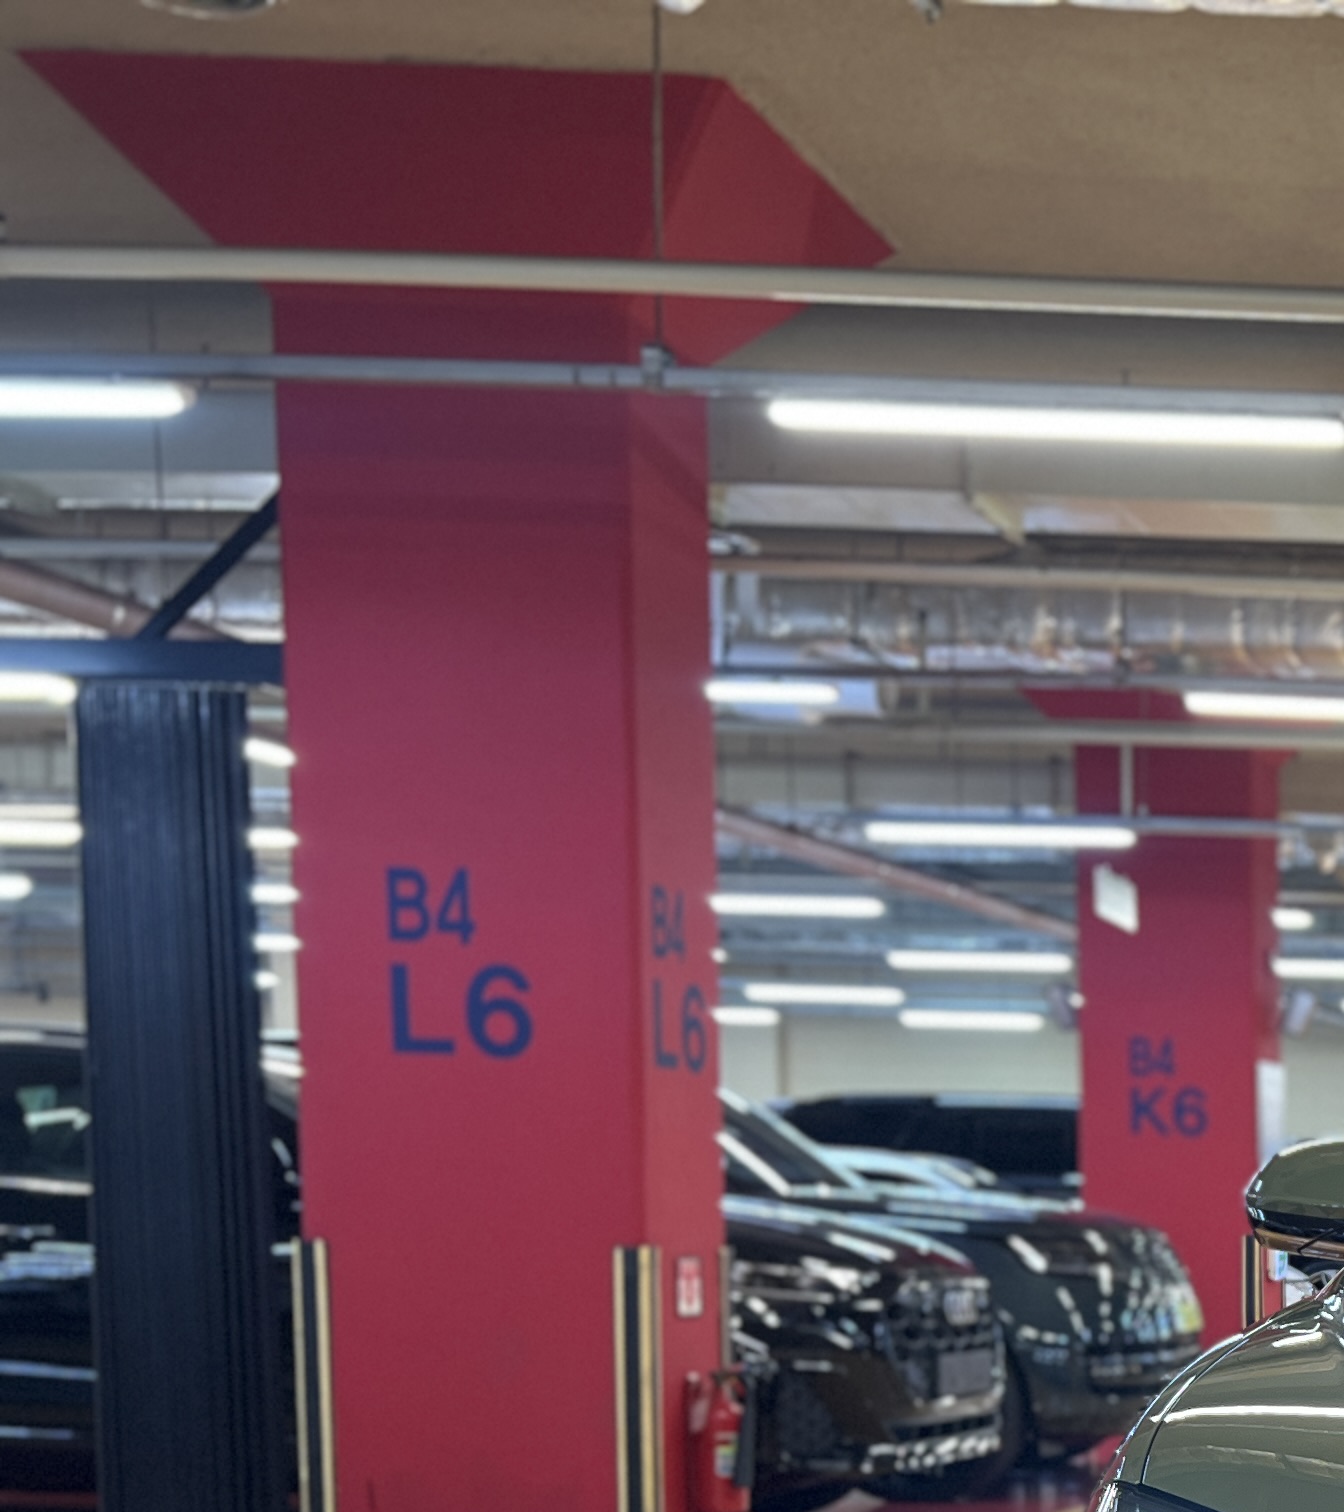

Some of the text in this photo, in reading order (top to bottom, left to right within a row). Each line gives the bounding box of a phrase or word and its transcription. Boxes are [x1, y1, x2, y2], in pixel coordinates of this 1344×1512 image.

[385, 865, 476, 945] B4
[649, 885, 687, 959] B4
[388, 962, 534, 1060] L6
[651, 979, 707, 1074] L6
[1127, 1034, 1176, 1078] B4
[1129, 1085, 1209, 1138] K6
